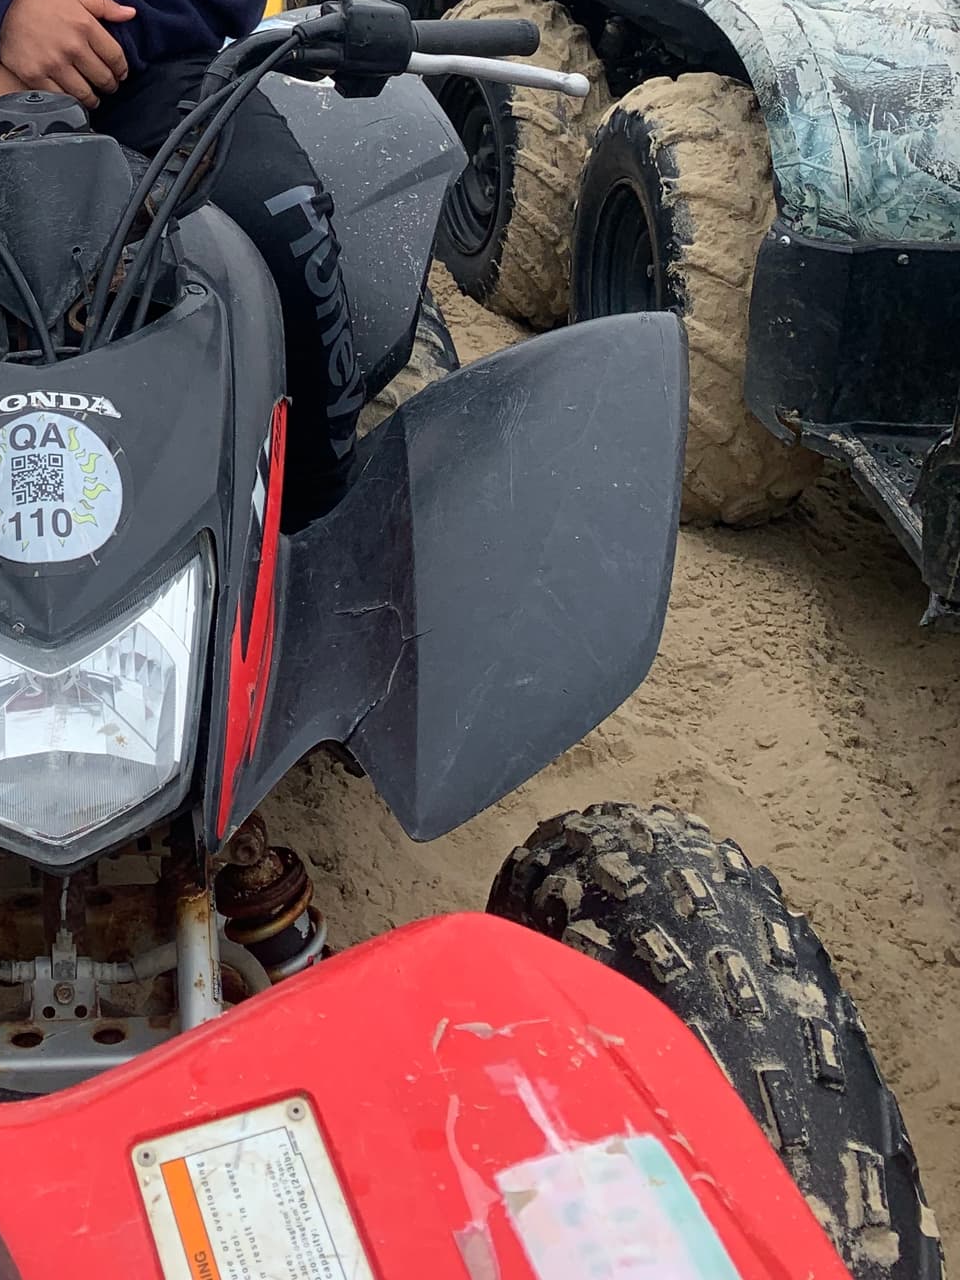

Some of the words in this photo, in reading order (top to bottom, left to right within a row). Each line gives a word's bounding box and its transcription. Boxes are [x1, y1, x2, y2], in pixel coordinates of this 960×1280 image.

[8, 422, 67, 451] QA
[8, 507, 73, 541] 110
[196, 1161, 223, 1232] overloading
[224, 1162, 242, 1199] severe
[244, 1226, 262, 1263] result
